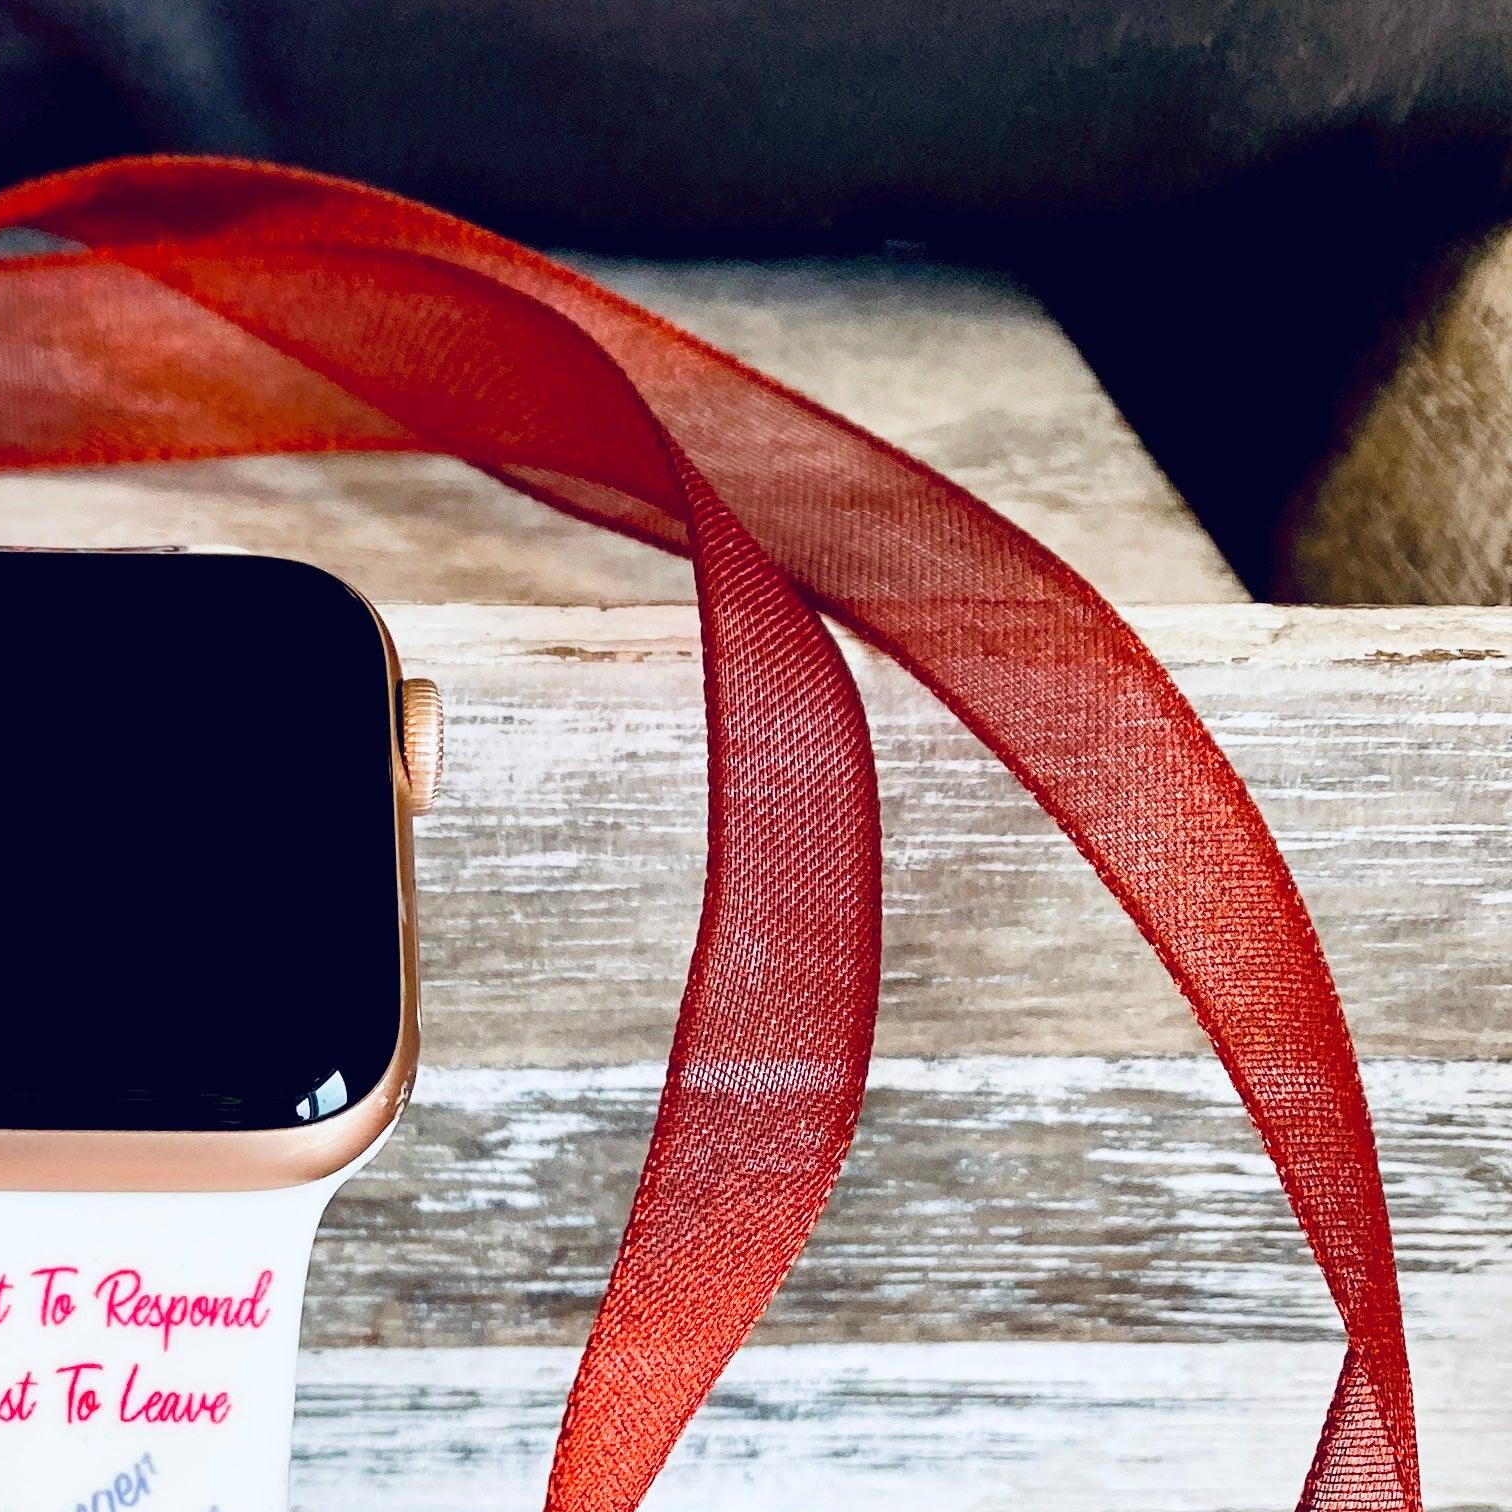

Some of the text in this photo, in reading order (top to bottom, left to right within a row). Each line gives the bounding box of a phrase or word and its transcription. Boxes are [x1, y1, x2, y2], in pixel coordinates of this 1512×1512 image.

[31, 1266, 78, 1327] To
[94, 1269, 274, 1352] Respond
[56, 1363, 104, 1424] To
[120, 1363, 232, 1424] Leave
